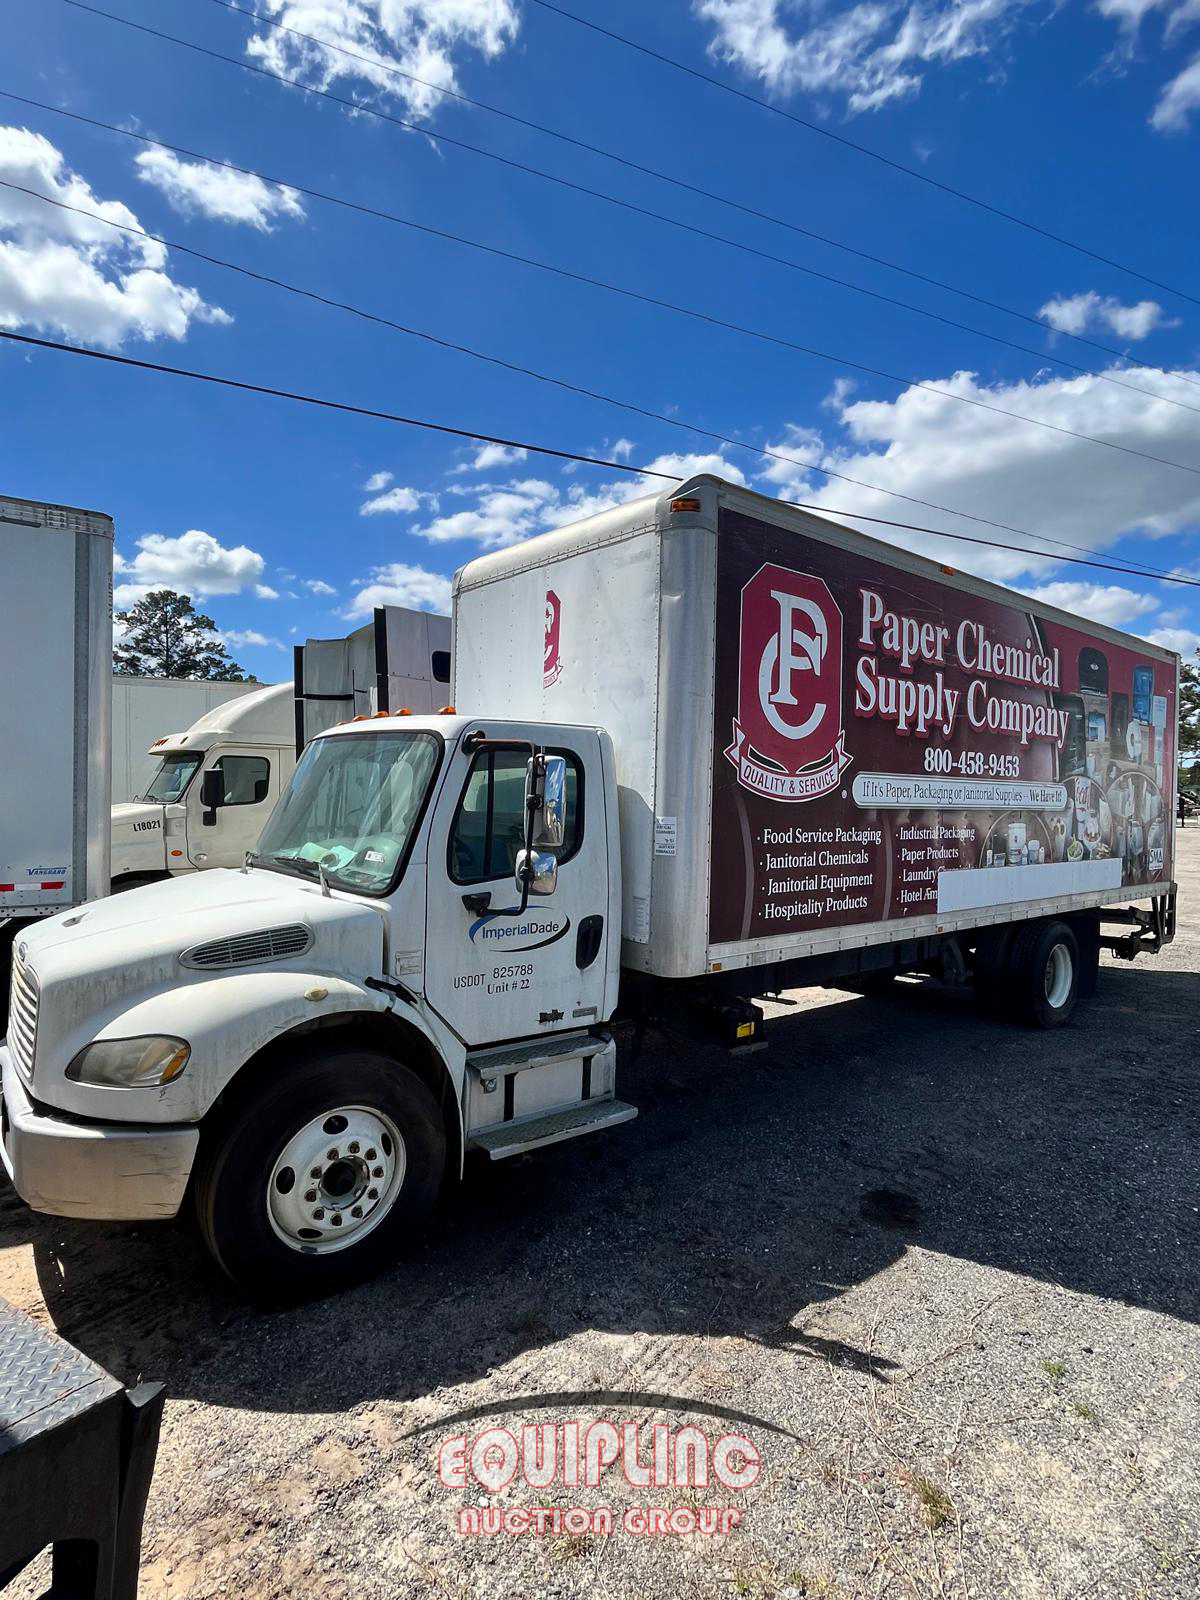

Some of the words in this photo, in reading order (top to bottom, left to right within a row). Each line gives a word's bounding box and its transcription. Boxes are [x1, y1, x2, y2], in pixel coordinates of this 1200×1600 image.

[858, 588, 949, 669] Paper
[957, 620, 1060, 688] Chemical
[855, 656, 959, 735] Supply
[967, 680, 1070, 749] Company
[924, 747, 1020, 778] 800-458-9453
[743, 764, 786, 793] QUALITY
[788, 780, 796, 794] &
[798, 769, 836, 794] SERVICE
[862, 781, 871, 797] If
[871, 781, 884, 798] It's
[885, 784, 912, 804] Paper,
[914, 784, 953, 805] Packaging
[954, 788, 962, 800] or
[963, 785, 994, 801] Janitorial
[996, 788, 1023, 806] Supplies
[1029, 789, 1040, 802] We
[1040, 790, 1054, 802] Have
[133, 819, 161, 832] L18021
[900, 827, 938, 841] Industrial
[939, 826, 976, 841] Packaging
[763, 828, 793, 845] Food
[795, 828, 833, 844] Service
[835, 827, 882, 846] Packaging
[765, 851, 817, 872] Janitorial
[818, 849, 869, 867] Chemicals
[901, 848, 926, 865] Paper
[926, 846, 959, 861] Products
[27, 867, 67, 876] VANGUARD
[902, 866, 937, 884] Laundry
[767, 875, 818, 896] Janitorial
[820, 872, 873, 892] Equipment
[900, 887, 923, 904] Hotel
[764, 900, 824, 921] Hospitality
[826, 894, 868, 910] Products
[482, 921, 560, 941] ImperialDade
[453, 973, 487, 990] USDOT
[492, 964, 534, 980] 825788
[487, 982, 510, 995] Unit
[511, 981, 518, 992] #
[520, 979, 530, 990] 22
